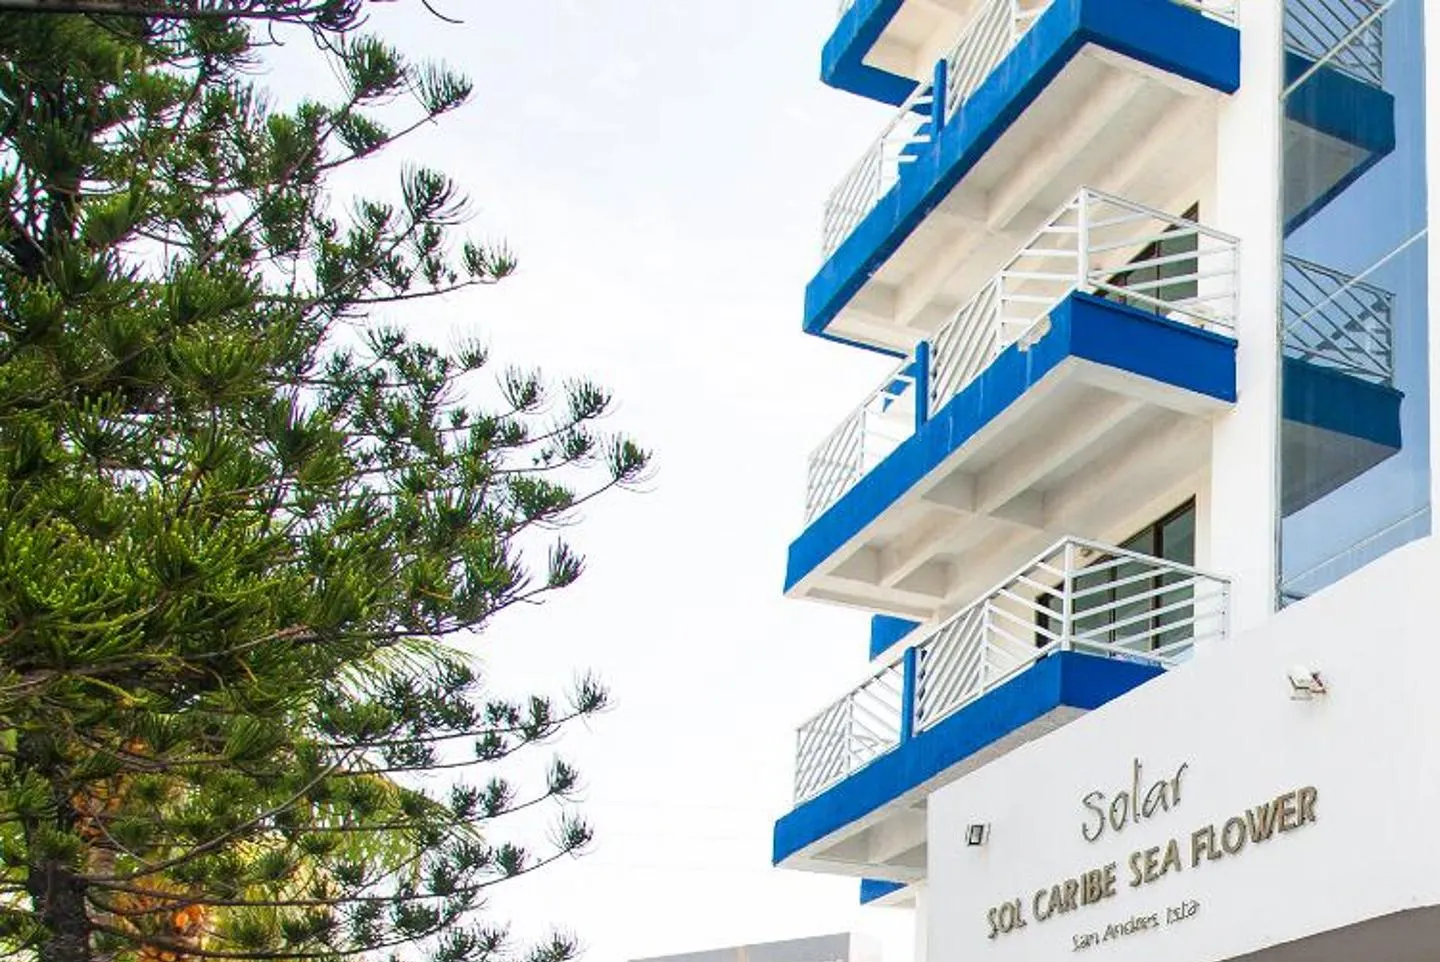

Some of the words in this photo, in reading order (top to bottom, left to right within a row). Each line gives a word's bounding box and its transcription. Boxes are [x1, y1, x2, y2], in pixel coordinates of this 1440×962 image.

[1082, 758, 1189, 842] Solar
[987, 898, 1028, 939] SOL
[1033, 862, 1117, 925] CARIBE
[1128, 838, 1182, 888] SEA
[1191, 786, 1318, 868] FLOWER
[1072, 931, 1099, 952] San
